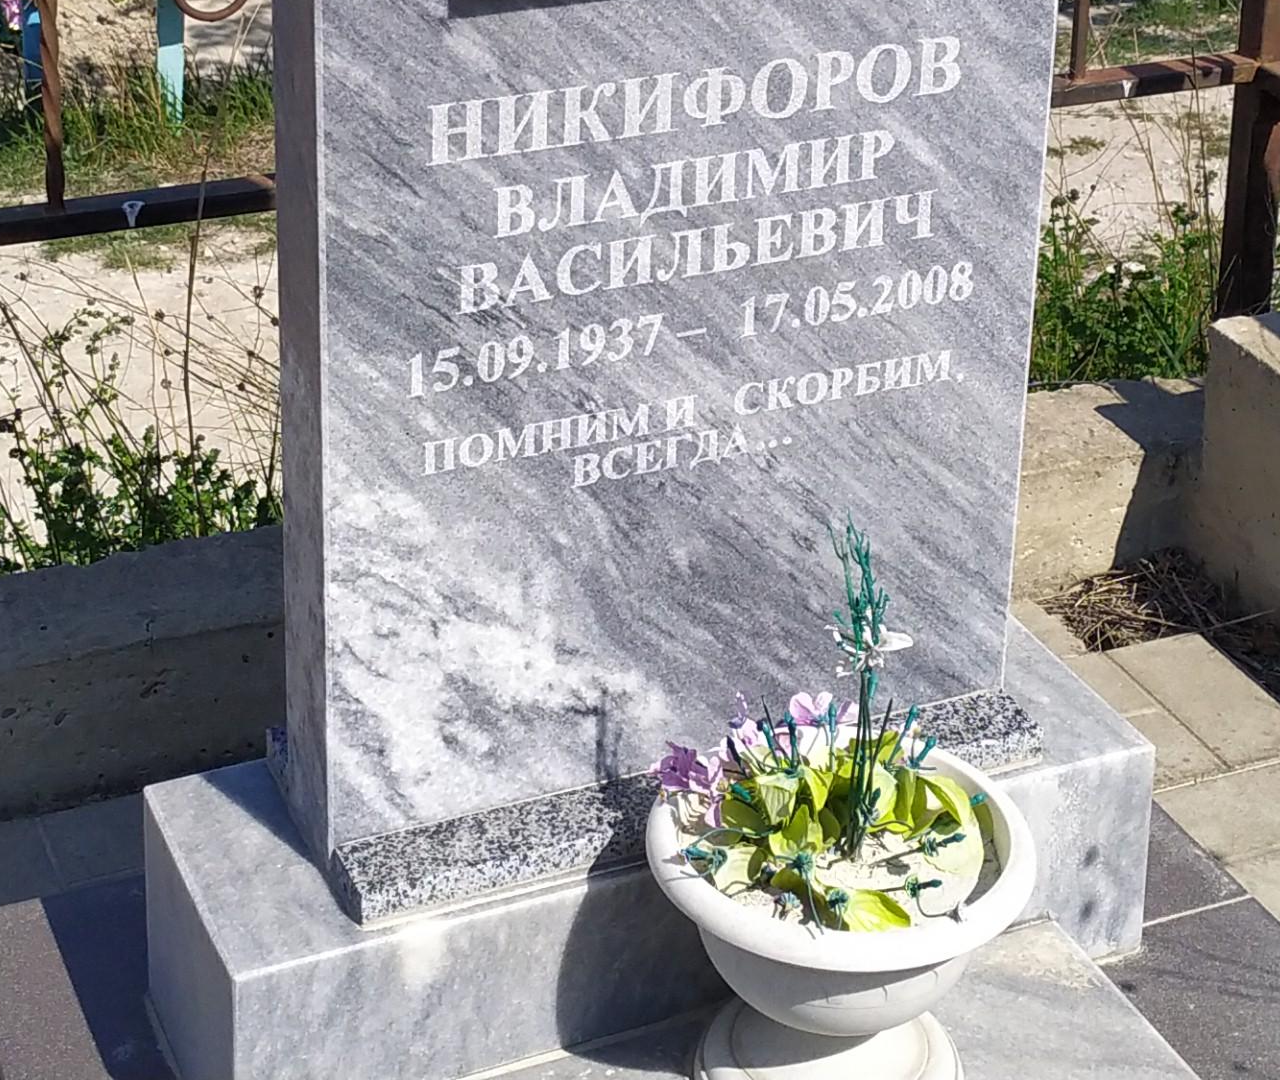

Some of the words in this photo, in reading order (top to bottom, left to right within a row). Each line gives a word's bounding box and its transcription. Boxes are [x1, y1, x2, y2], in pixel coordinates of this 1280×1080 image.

[425, 35, 963, 167] НИКИФОРОВ
[493, 129, 896, 239] ВЛАДИМИР
[455, 189, 939, 315] ВАСИЛЬЕВИЧ
[406, 313, 665, 398] 15.09.1937
[735, 261, 974, 339] 17.05.2008
[421, 403, 651, 476] ПОМНИМ
[664, 394, 698, 432] И
